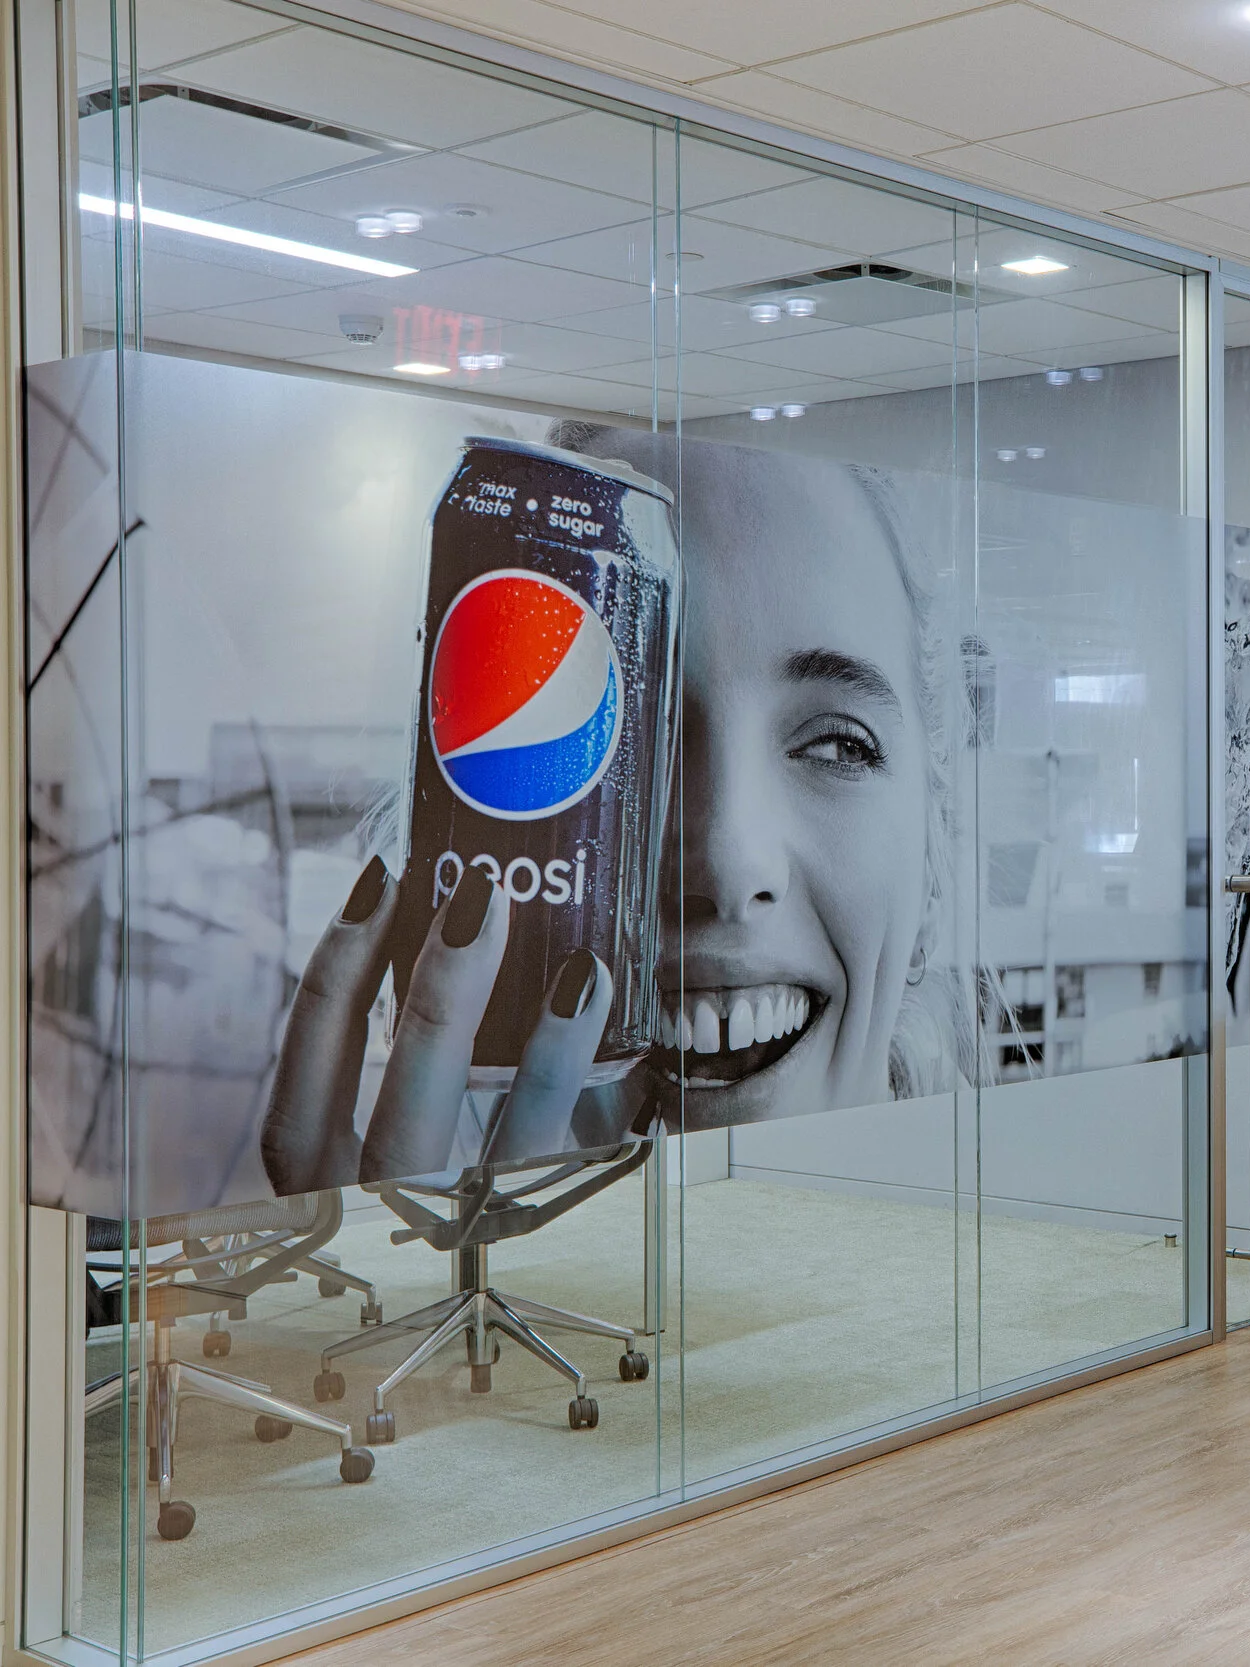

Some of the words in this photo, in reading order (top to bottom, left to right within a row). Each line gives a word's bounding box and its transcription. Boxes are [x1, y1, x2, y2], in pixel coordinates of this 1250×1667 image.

[479, 482, 517, 500] max
[470, 495, 512, 517] taste
[551, 495, 592, 516] zero
[549, 512, 604, 539] sugar
